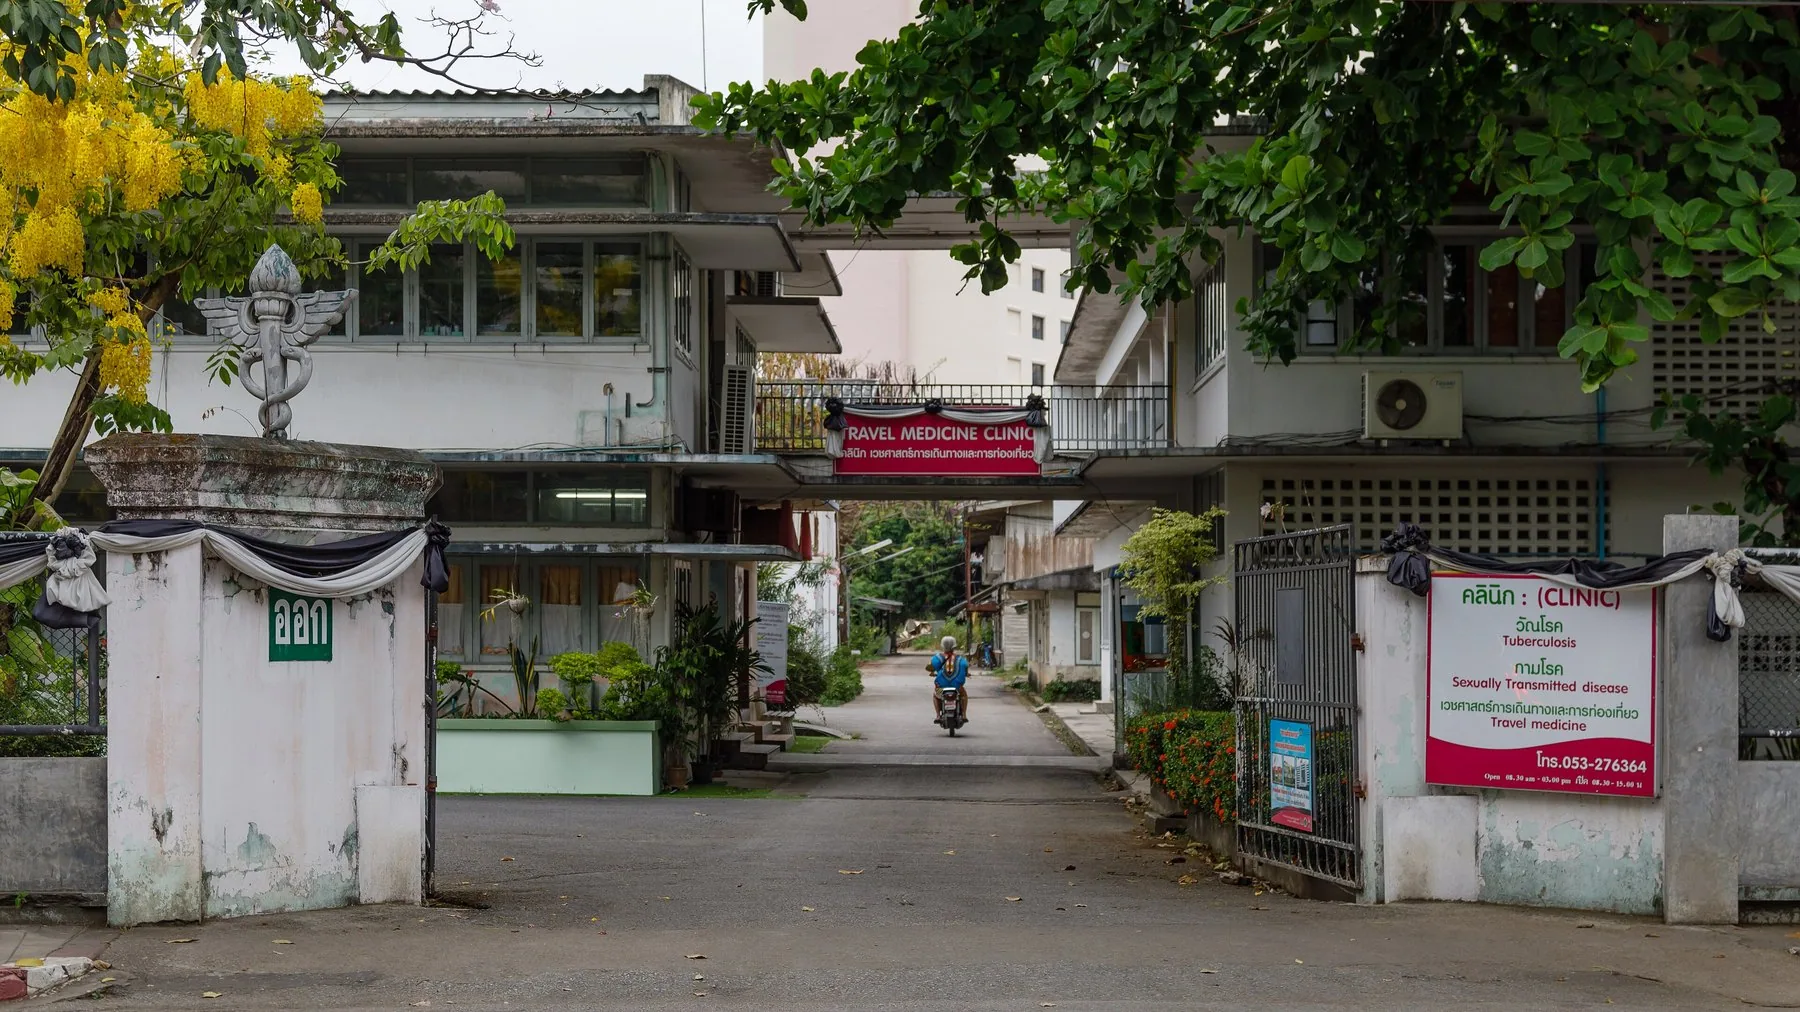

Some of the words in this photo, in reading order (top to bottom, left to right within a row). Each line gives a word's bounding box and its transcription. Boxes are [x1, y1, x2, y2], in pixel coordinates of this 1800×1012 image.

[901, 426, 978, 441] MEDICINE
[984, 426, 1035, 441] CLINIC
[1462, 584, 1515, 606] คลินิก
[1537, 586, 1621, 611] (CLINIC)
[274, 598, 328, 645] ออก
[1516, 615, 1563, 633] วัณโรค
[1503, 635, 1577, 648] Tuberculosis
[1515, 658, 1564, 676] กามโรค
[1452, 676, 1502, 692] Sexually
[1505, 679, 1577, 692] Transmitted
[1582, 681, 1629, 694] disease
[1440, 700, 1639, 720] เวชศาสตร์การเดินทางและการท่องเที่ยว
[1491, 717, 1527, 729] Travel
[1531, 718, 1587, 731] medicine
[1536, 751, 1648, 773] โทร.053-276364
[1484, 772, 1501, 781] Open
